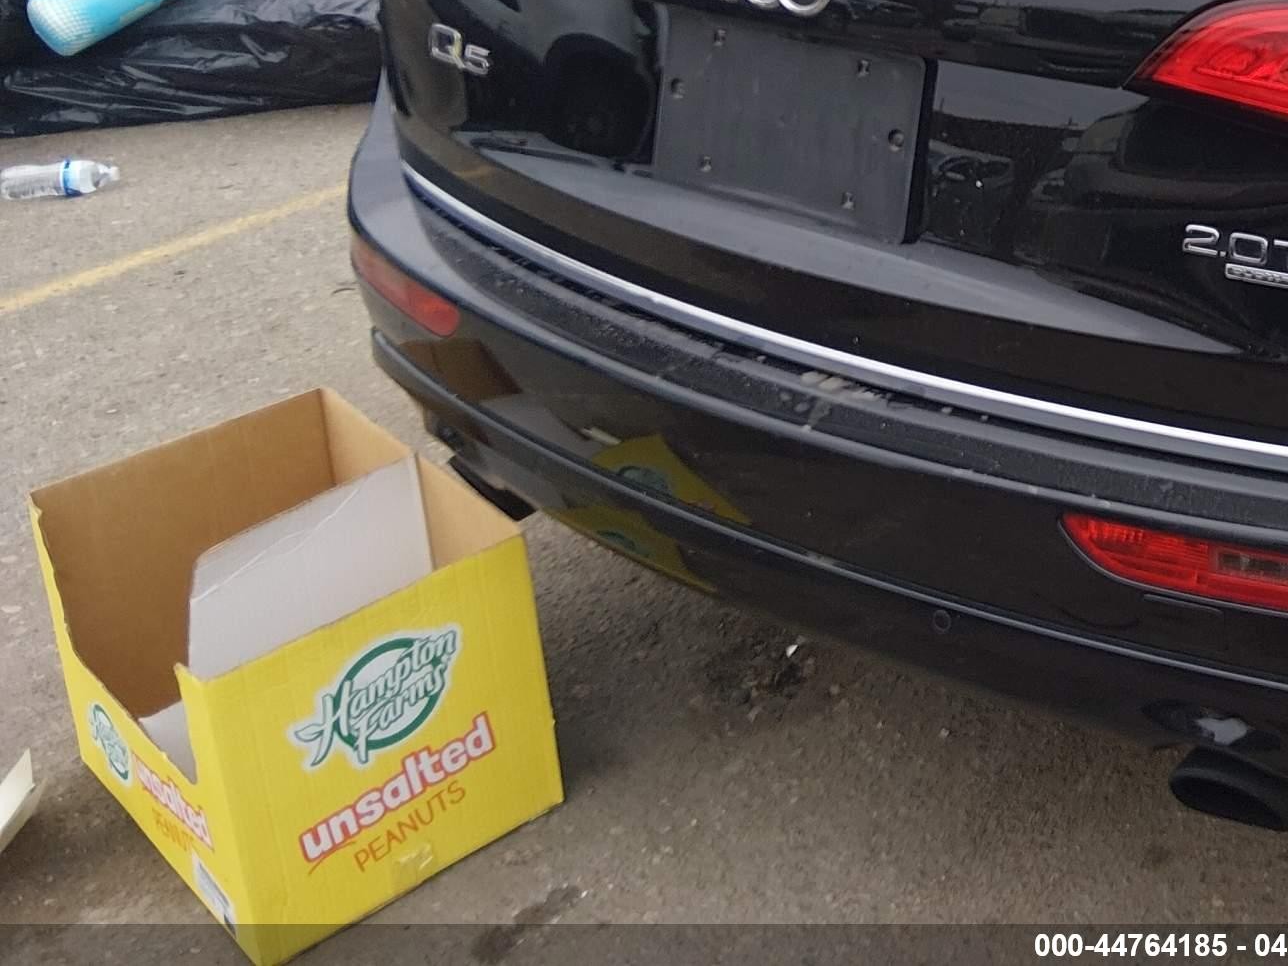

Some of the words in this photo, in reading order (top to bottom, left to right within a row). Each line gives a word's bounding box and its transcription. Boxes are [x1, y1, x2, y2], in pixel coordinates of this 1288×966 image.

[428, 22, 491, 76] Q5
[295, 630, 457, 767] Hampton
[299, 711, 496, 863] unsalted
[353, 780, 467, 873] PEANUTS
